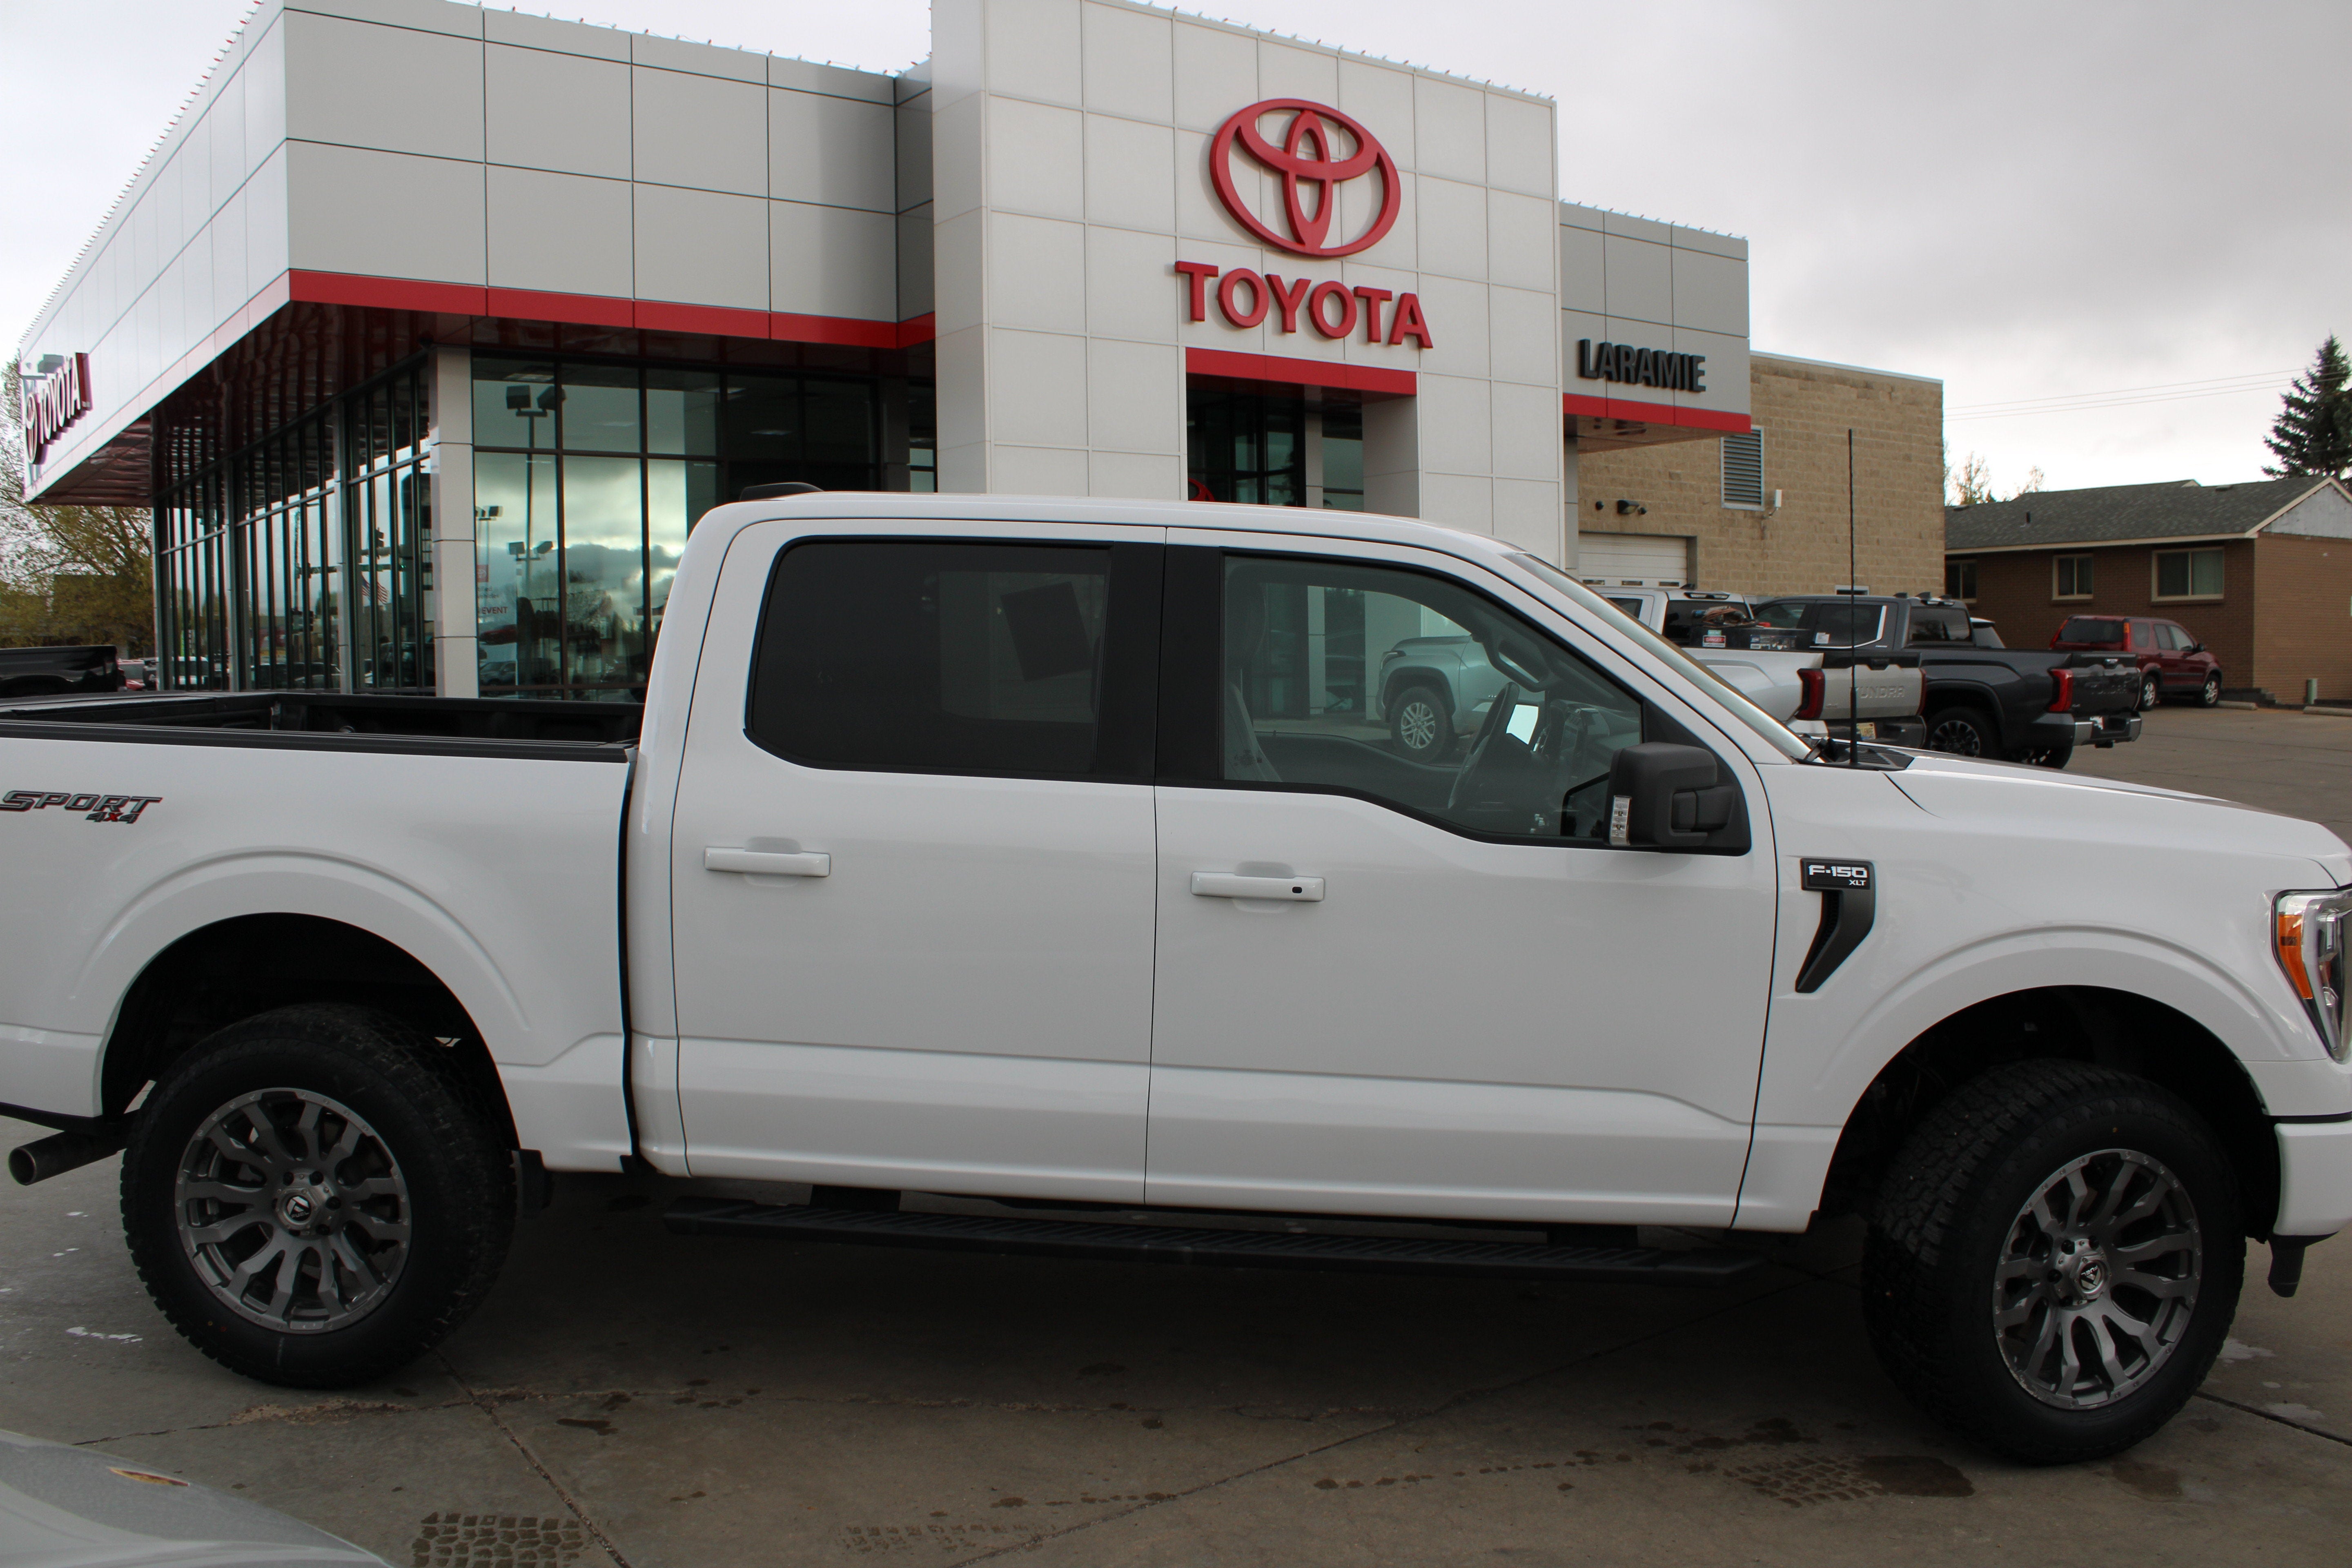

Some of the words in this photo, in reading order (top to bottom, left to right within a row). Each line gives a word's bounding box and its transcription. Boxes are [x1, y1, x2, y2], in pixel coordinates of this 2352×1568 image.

[1174, 261, 1434, 349] TOYOTA
[1579, 339, 1706, 392] LARAMIE
[38, 352, 88, 444] TOYOTA
[481, 606, 508, 615] EVENT
[1849, 686, 1904, 699] UNDRA
[0, 790, 163, 813] SPORT
[1808, 864, 1868, 878] F-150
